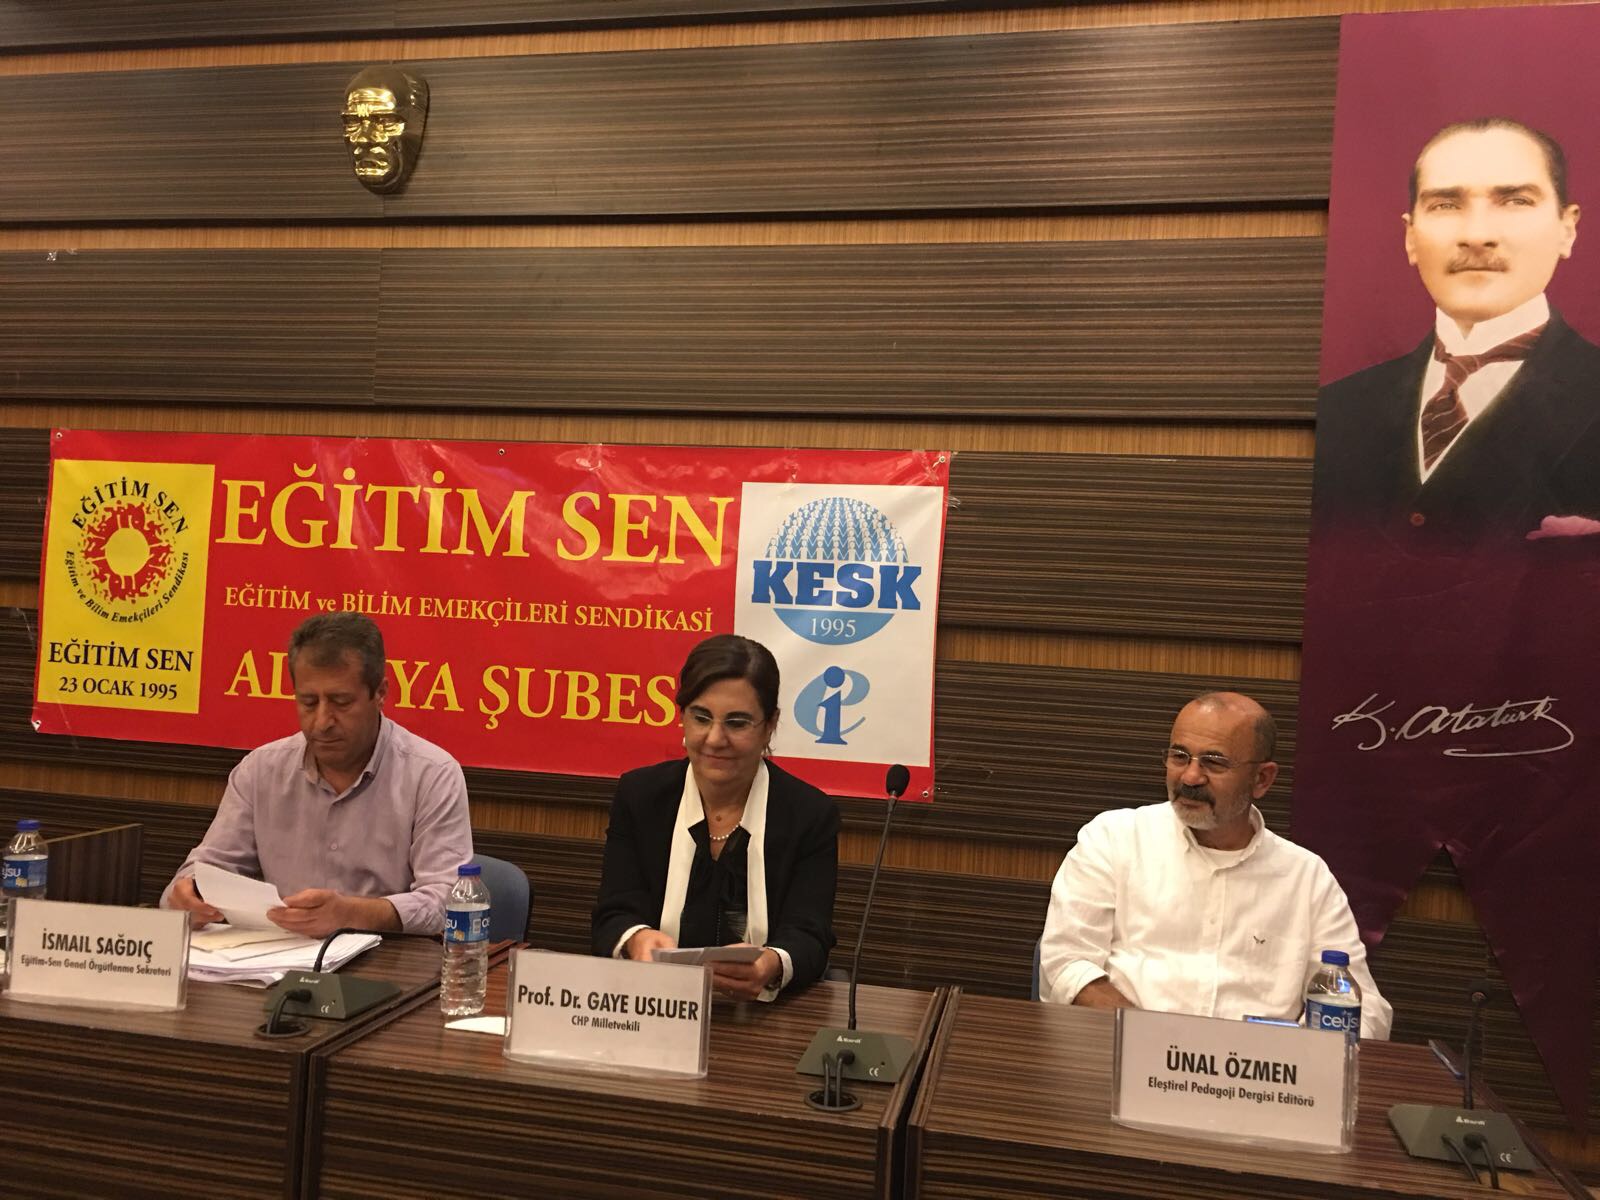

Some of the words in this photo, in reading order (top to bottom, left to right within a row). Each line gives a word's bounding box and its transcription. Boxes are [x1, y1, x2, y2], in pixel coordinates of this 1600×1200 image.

[72, 477, 150, 529] EĞİTİM
[153, 491, 189, 534] SEN
[215, 462, 535, 557] EĞİTİM
[556, 491, 734, 566] SEN
[65, 550, 79, 587] Eğitim
[77, 589, 86, 599] ve
[85, 599, 109, 618] Bilim
[111, 600, 164, 623] Emekçileri
[162, 552, 189, 604] Sendikası
[751, 560, 921, 610] KESK
[224, 583, 311, 610] EĞİTİM
[316, 598, 336, 611] ve
[342, 589, 412, 616] BİLİM
[418, 597, 568, 627] EMEKÇİLERİ
[810, 618, 856, 638] 1995
[48, 638, 138, 668] EĞİTİM
[146, 648, 193, 672] SEN
[58, 676, 78, 692] 23
[82, 678, 133, 696] OCAK
[140, 682, 178, 700] 1995
[224, 649, 464, 712] ALYA
[479, 665, 683, 730] ŞUBES
[21, 954, 62, 967] Eğitim-Sen
[64, 958, 86, 969] Genel
[136, 965, 171, 976] Sekreteri
[96, 934, 153, 963] SAĞDIÇ
[517, 984, 554, 1006] Prof.
[560, 988, 581, 1008] Dr.
[587, 991, 629, 1013] GAYE
[635, 996, 699, 1020] USLUER
[571, 1015, 589, 1026] CHP
[591, 1016, 640, 1032] Milletvekili
[1166, 1045, 1219, 1076] ÜNAL
[1225, 1052, 1297, 1085] ÖZMEN
[1148, 1076, 1188, 1092] Eleştirel
[1191, 1082, 1235, 1100] Pedagoji
[1239, 1087, 1275, 1103] Dergisi
[1278, 1092, 1314, 1107] Editörü
